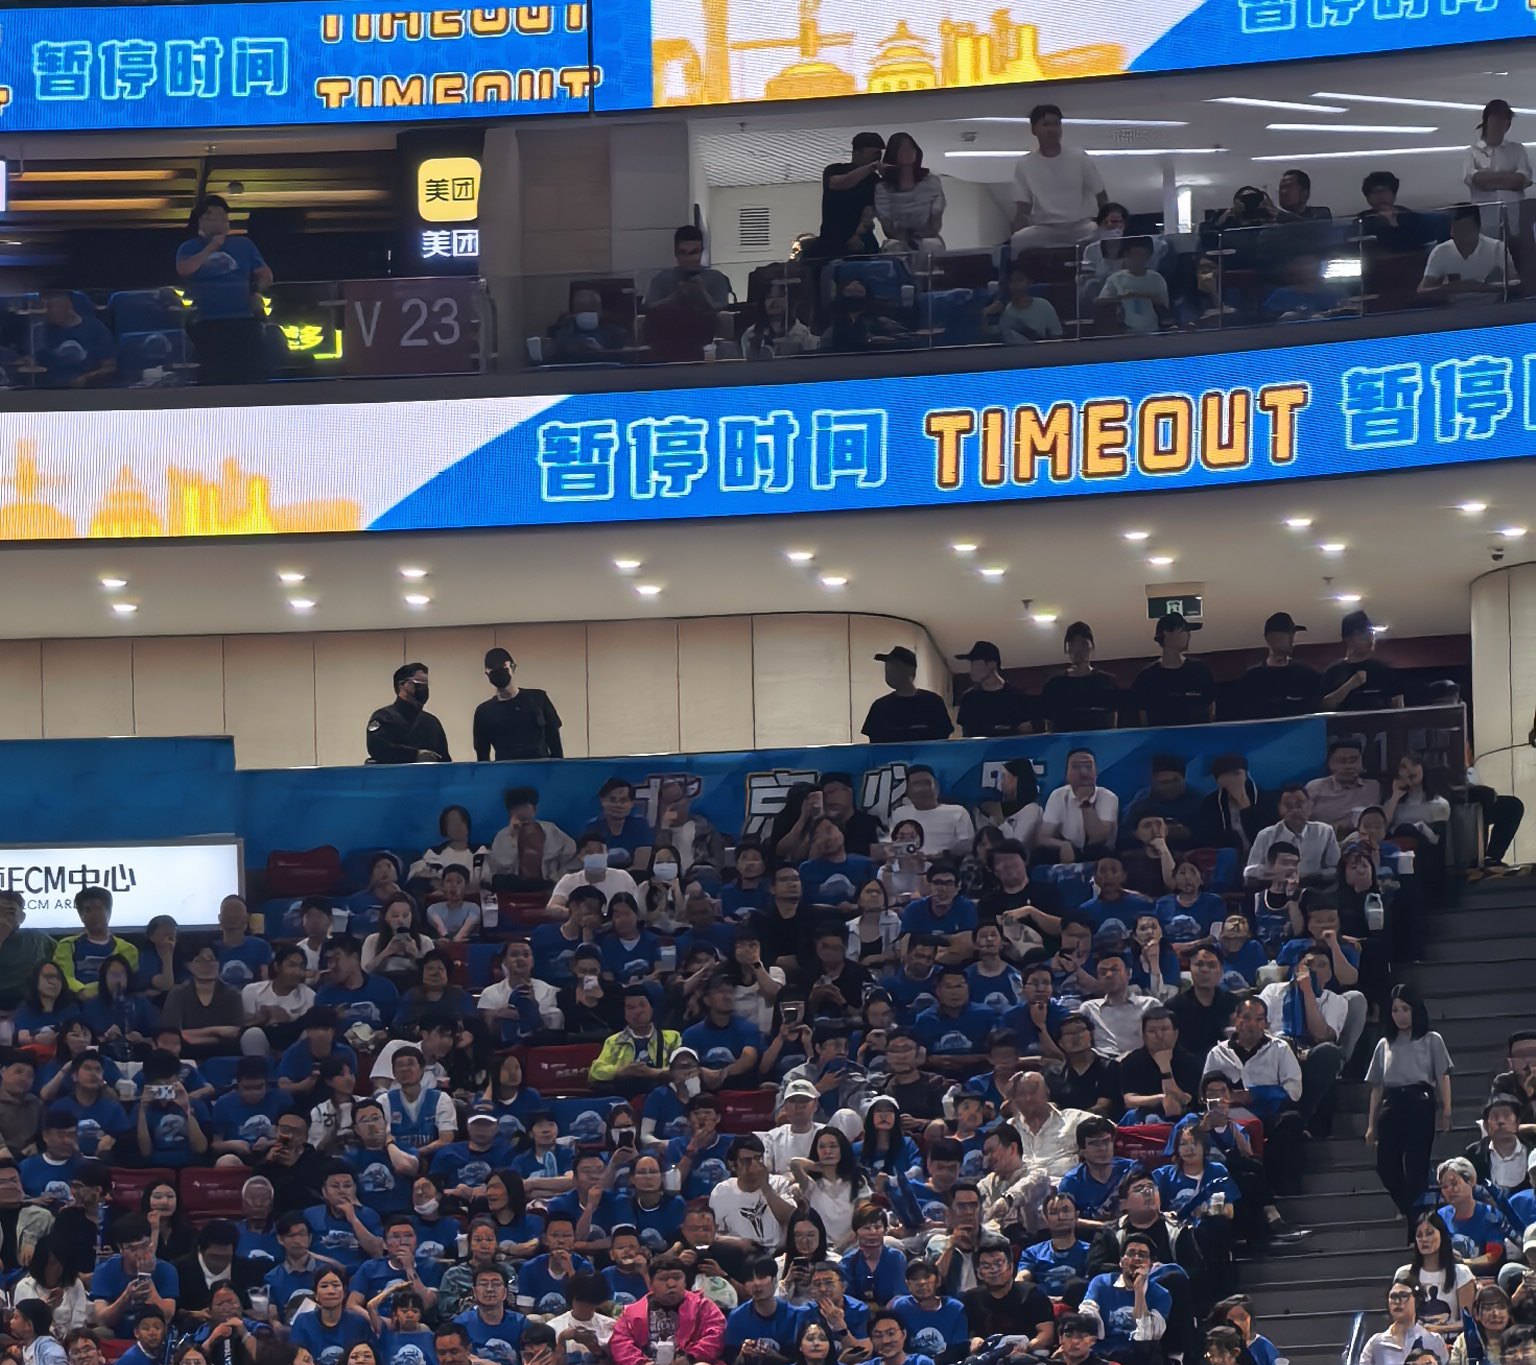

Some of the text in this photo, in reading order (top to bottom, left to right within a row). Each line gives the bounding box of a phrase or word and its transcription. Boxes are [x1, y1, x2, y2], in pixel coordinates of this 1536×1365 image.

[31, 36, 289, 100] 暂停时间
[424, 177, 476, 203] 美团
[420, 229, 480, 258] 美团
[354, 301, 382, 347] V
[400, 298, 461, 346] 23
[538, 409, 888, 502] 暂停时间
[925, 383, 1309, 489] TIMEOUT
